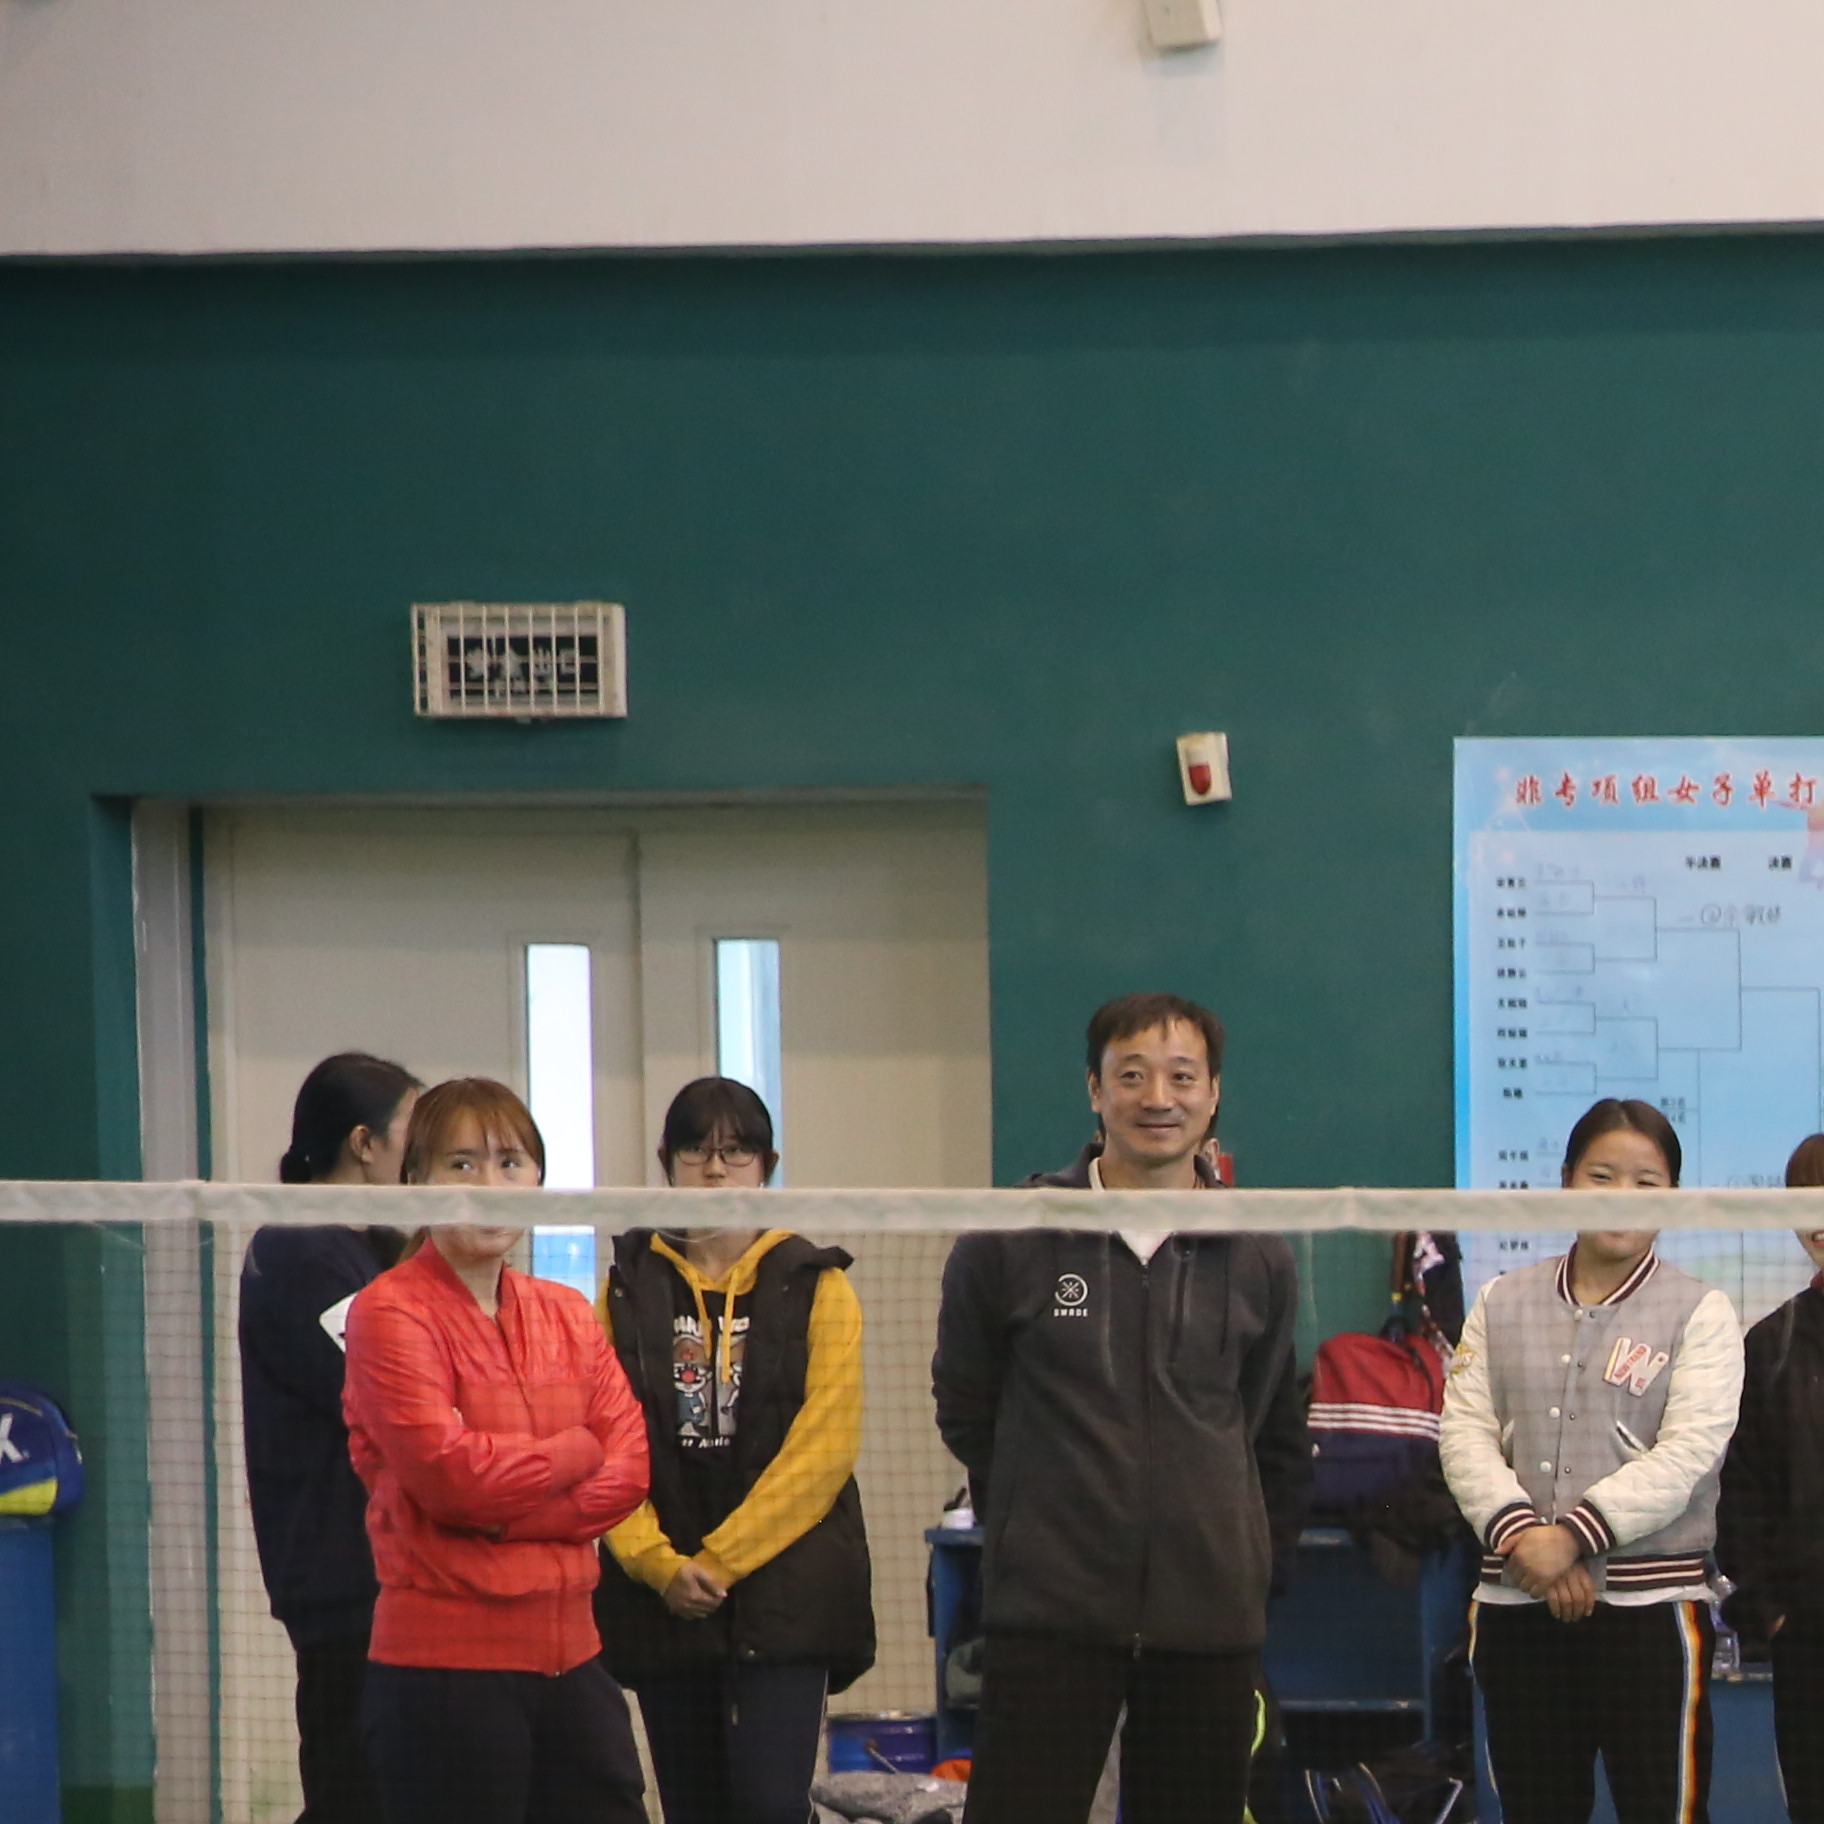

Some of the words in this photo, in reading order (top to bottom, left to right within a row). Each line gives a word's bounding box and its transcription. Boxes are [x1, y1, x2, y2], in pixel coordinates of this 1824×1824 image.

[1516, 769, 1817, 807] 非专项组女子单打
[1768, 855, 1793, 871] 决赛
